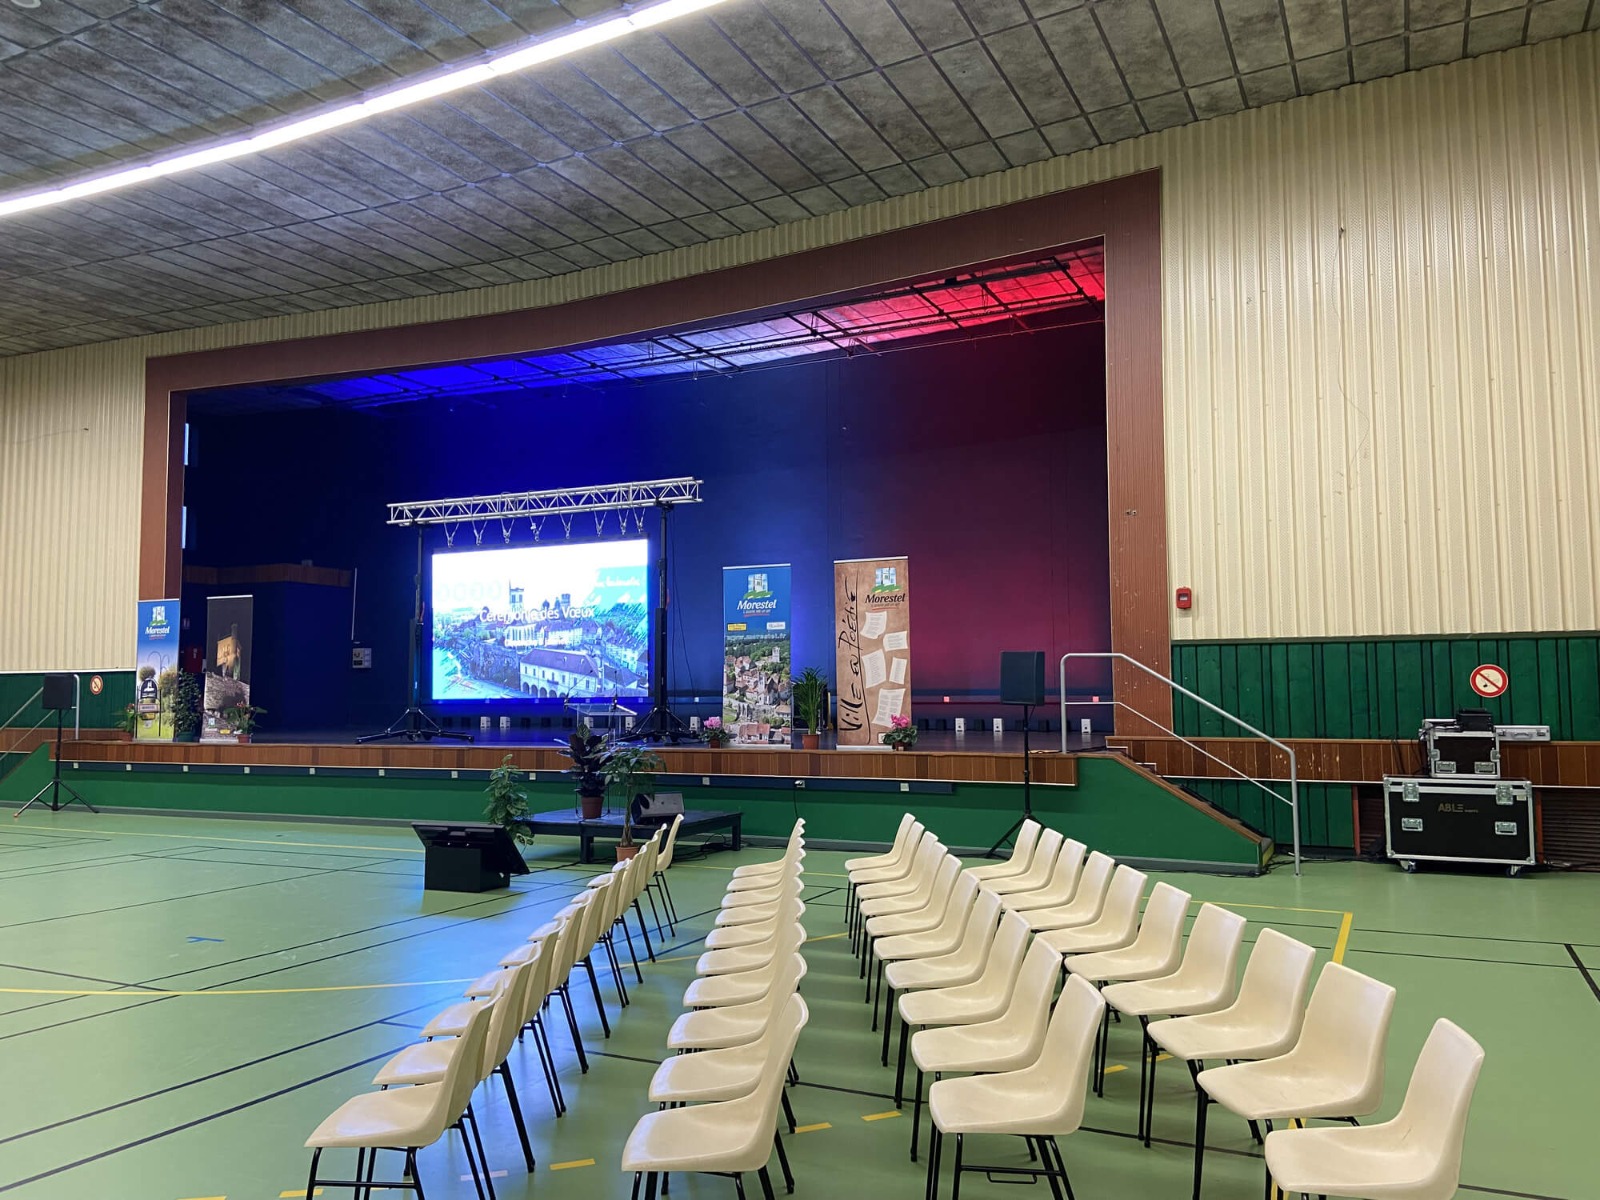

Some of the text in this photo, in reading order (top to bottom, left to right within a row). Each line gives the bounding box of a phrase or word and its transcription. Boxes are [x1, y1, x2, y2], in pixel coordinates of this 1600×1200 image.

[865, 593, 906, 604] Morestel
[737, 599, 777, 610] Morestel
[541, 606, 560, 620] des
[562, 605, 596, 619] Vœux
[145, 626, 170, 635] Morestel
[1438, 803, 1464, 813] ABLE
